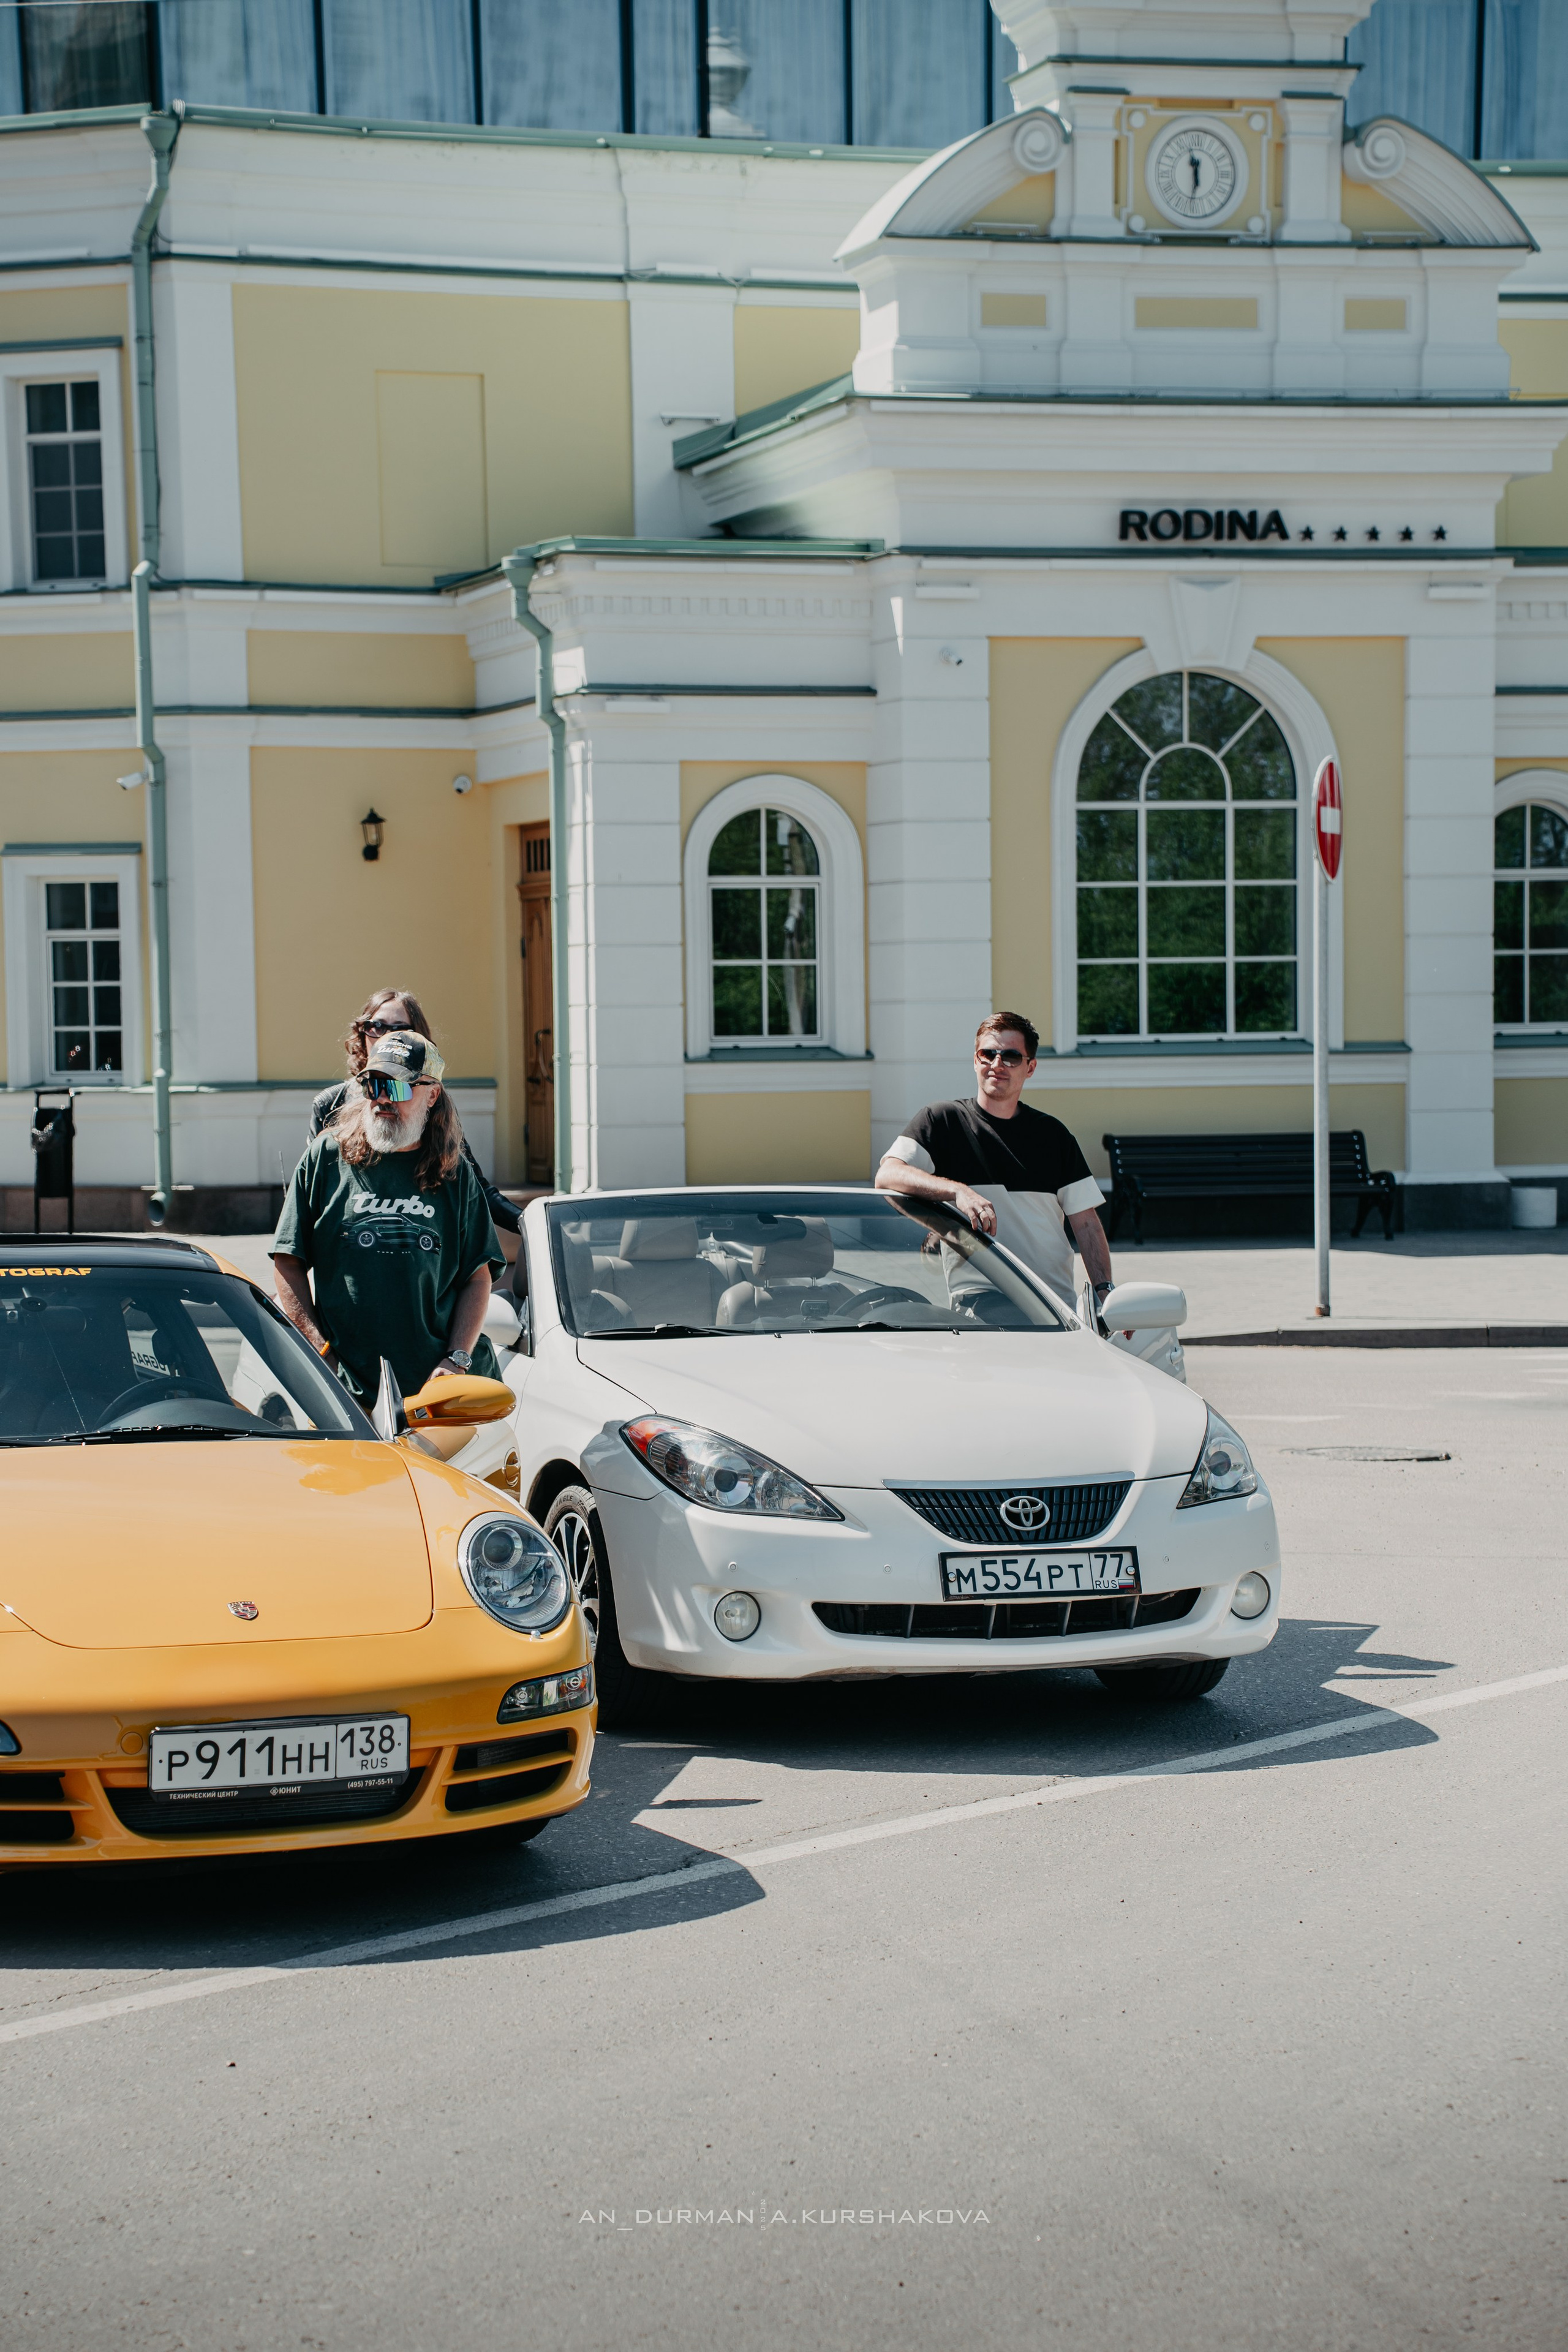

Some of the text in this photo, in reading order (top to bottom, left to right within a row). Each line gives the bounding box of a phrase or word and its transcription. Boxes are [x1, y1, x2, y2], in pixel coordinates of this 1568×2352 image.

[1118, 509, 1289, 541] RODINA
[352, 1191, 435, 1218] turbo
[1094, 1553, 1124, 1578] 77
[1095, 1580, 1117, 1589] RUS
[340, 1724, 395, 1758] 138
[361, 1757, 388, 1771] RUS
[365, 1778, 394, 1787] 797-55-11
[169, 1791, 216, 1800] ТЕХНИЧЕСКИЙ
